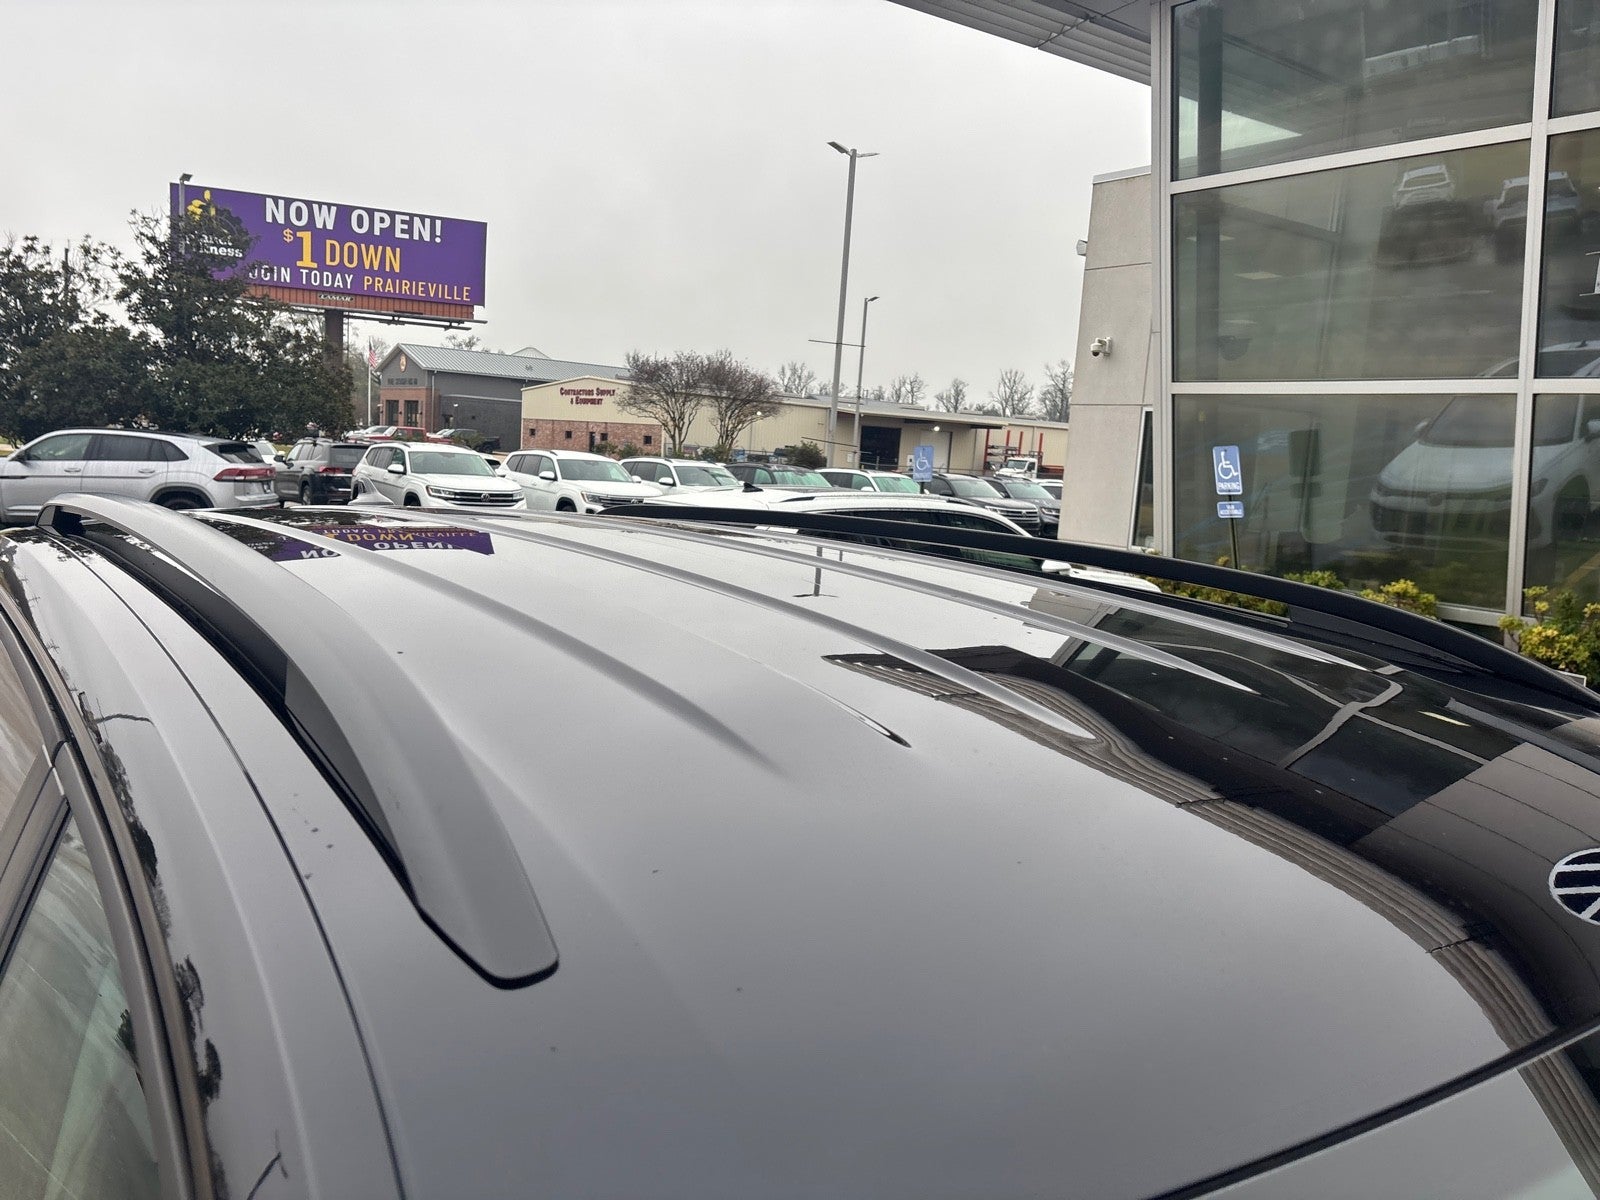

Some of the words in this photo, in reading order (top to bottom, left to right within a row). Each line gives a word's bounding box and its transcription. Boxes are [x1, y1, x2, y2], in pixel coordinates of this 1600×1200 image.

[265, 197, 337, 230] NOW
[351, 209, 442, 243] OPEN!
[283, 228, 318, 268] $1
[325, 239, 400, 273] DOWN
[248, 264, 291, 283] JOIN
[300, 269, 353, 289] TODAY
[364, 276, 471, 301] PRAIRIEVILLE
[596, 387, 616, 396] SUPPLY
